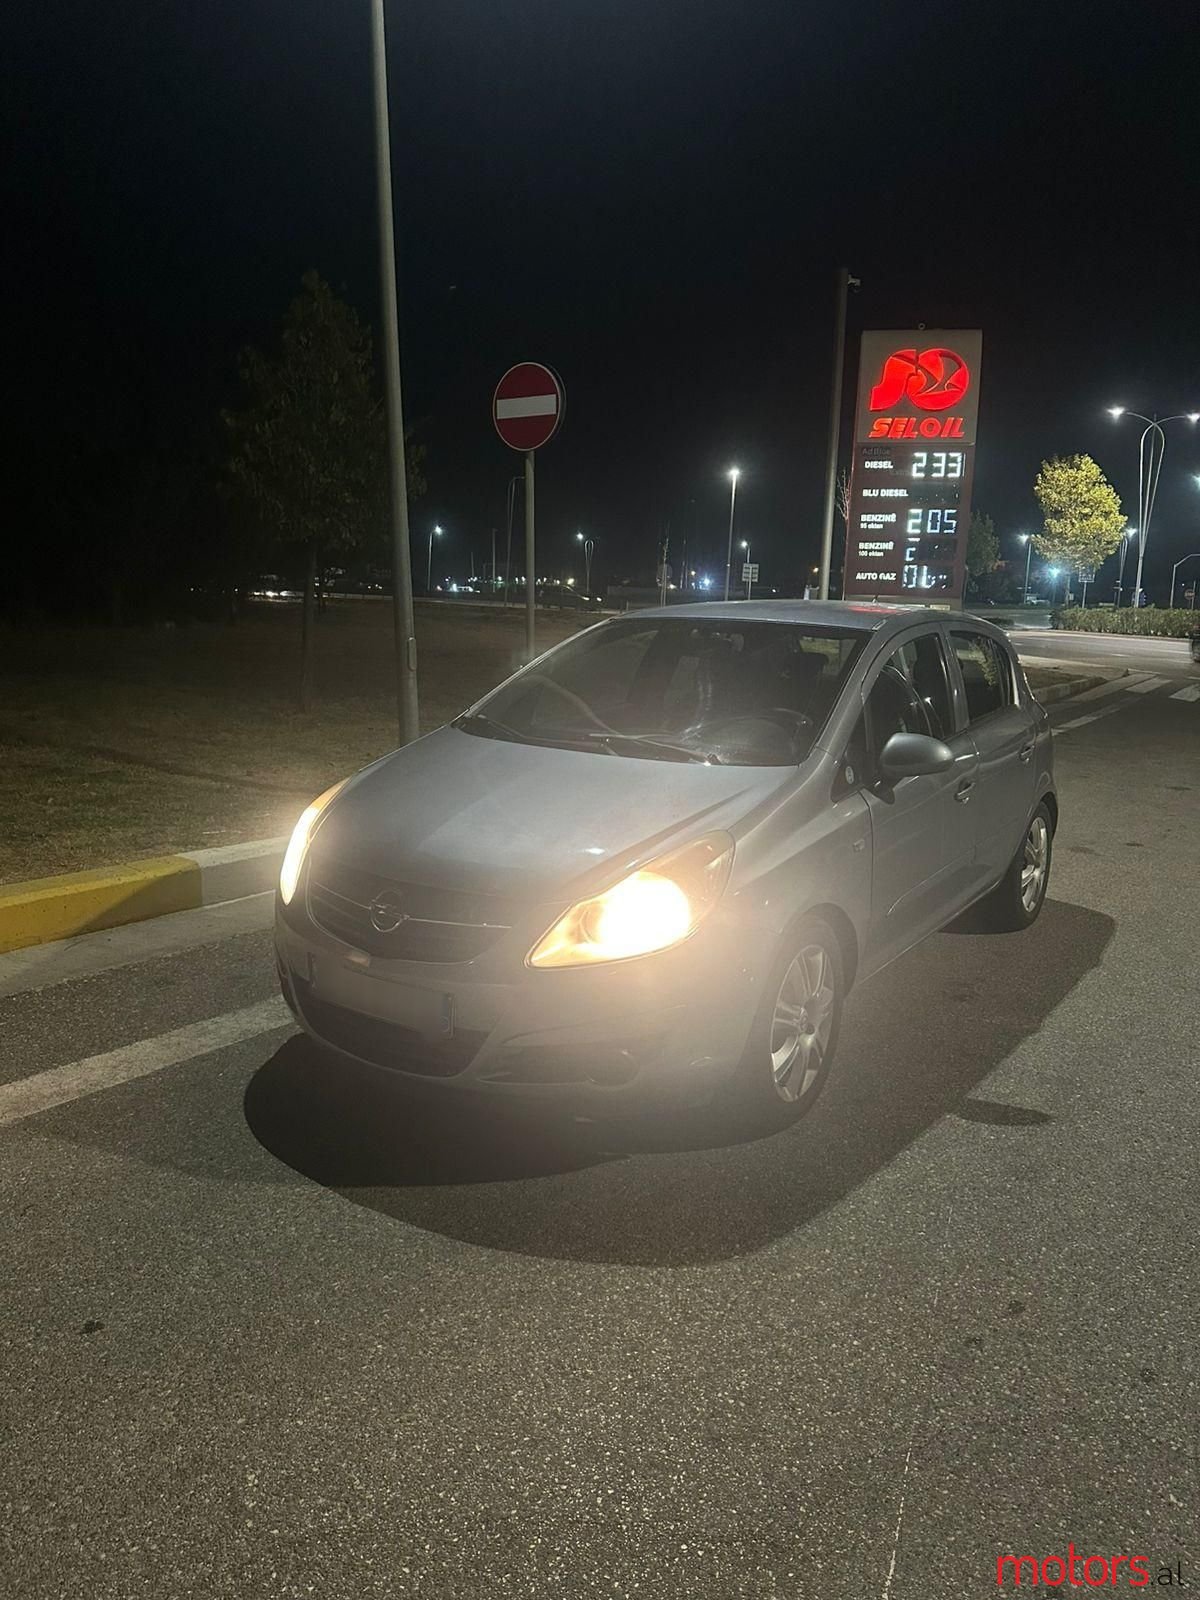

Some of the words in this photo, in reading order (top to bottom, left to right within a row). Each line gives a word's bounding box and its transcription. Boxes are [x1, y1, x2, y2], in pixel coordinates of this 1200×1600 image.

[868, 417, 965, 438] SELOIL
[864, 460, 894, 469] DIESEL
[912, 452, 962, 477] 233
[862, 489, 879, 497] BLU
[880, 489, 909, 497] DIESEL
[906, 509, 957, 533] 205
[856, 572, 878, 581] AUTO
